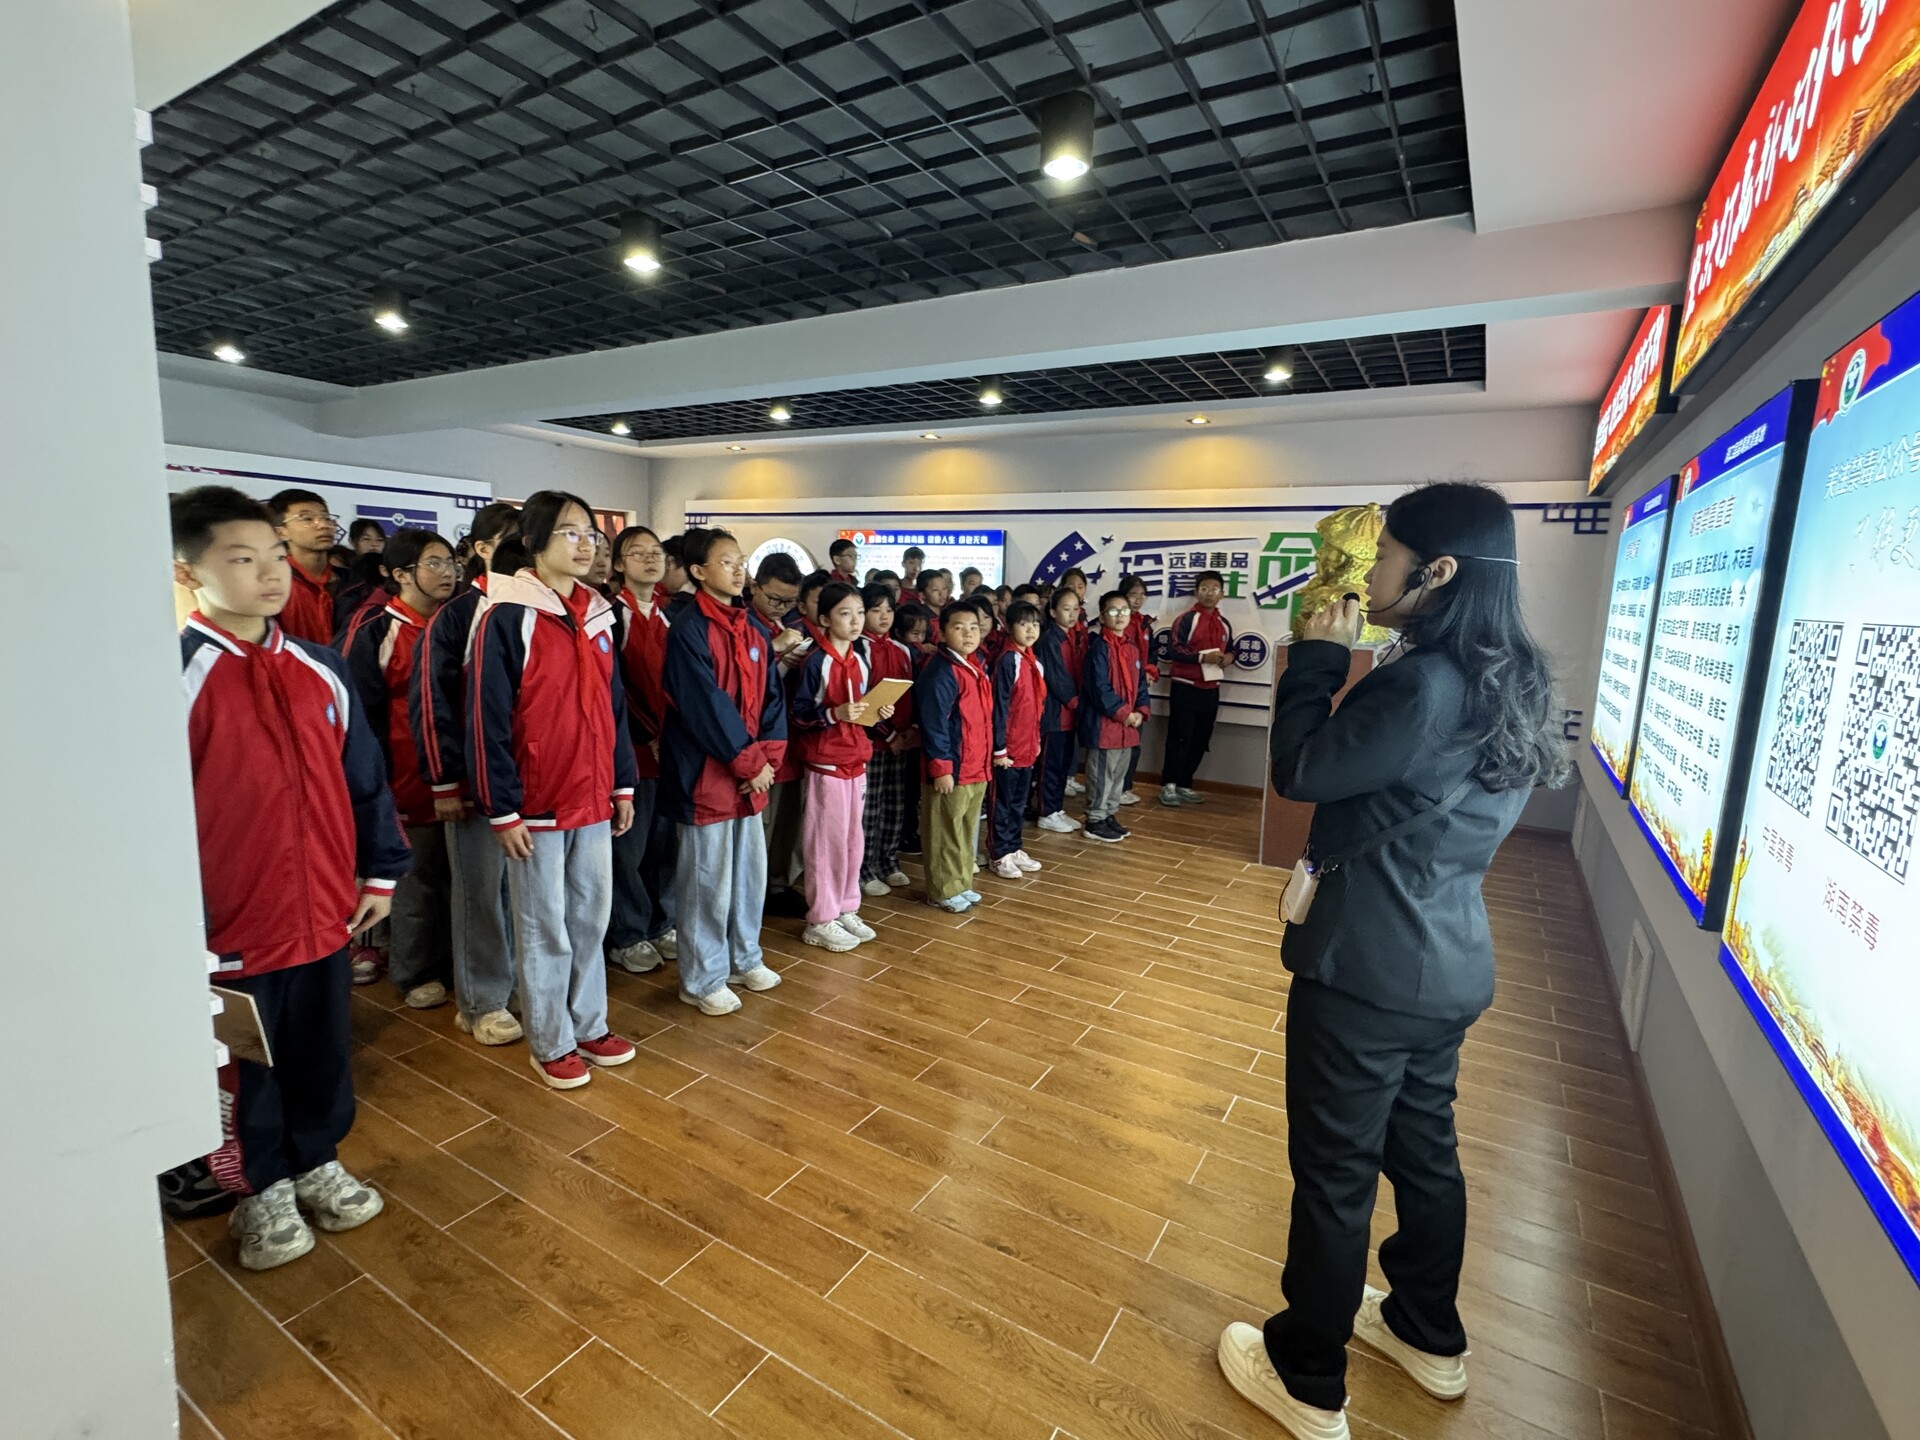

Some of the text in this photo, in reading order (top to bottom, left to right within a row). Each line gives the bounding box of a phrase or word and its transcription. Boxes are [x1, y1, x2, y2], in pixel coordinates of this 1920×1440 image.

[1168, 552, 1249, 569] 远离毒品
[1762, 822, 1795, 873] 中国禁毒
[1822, 876, 1881, 951] 湖南禁毒
